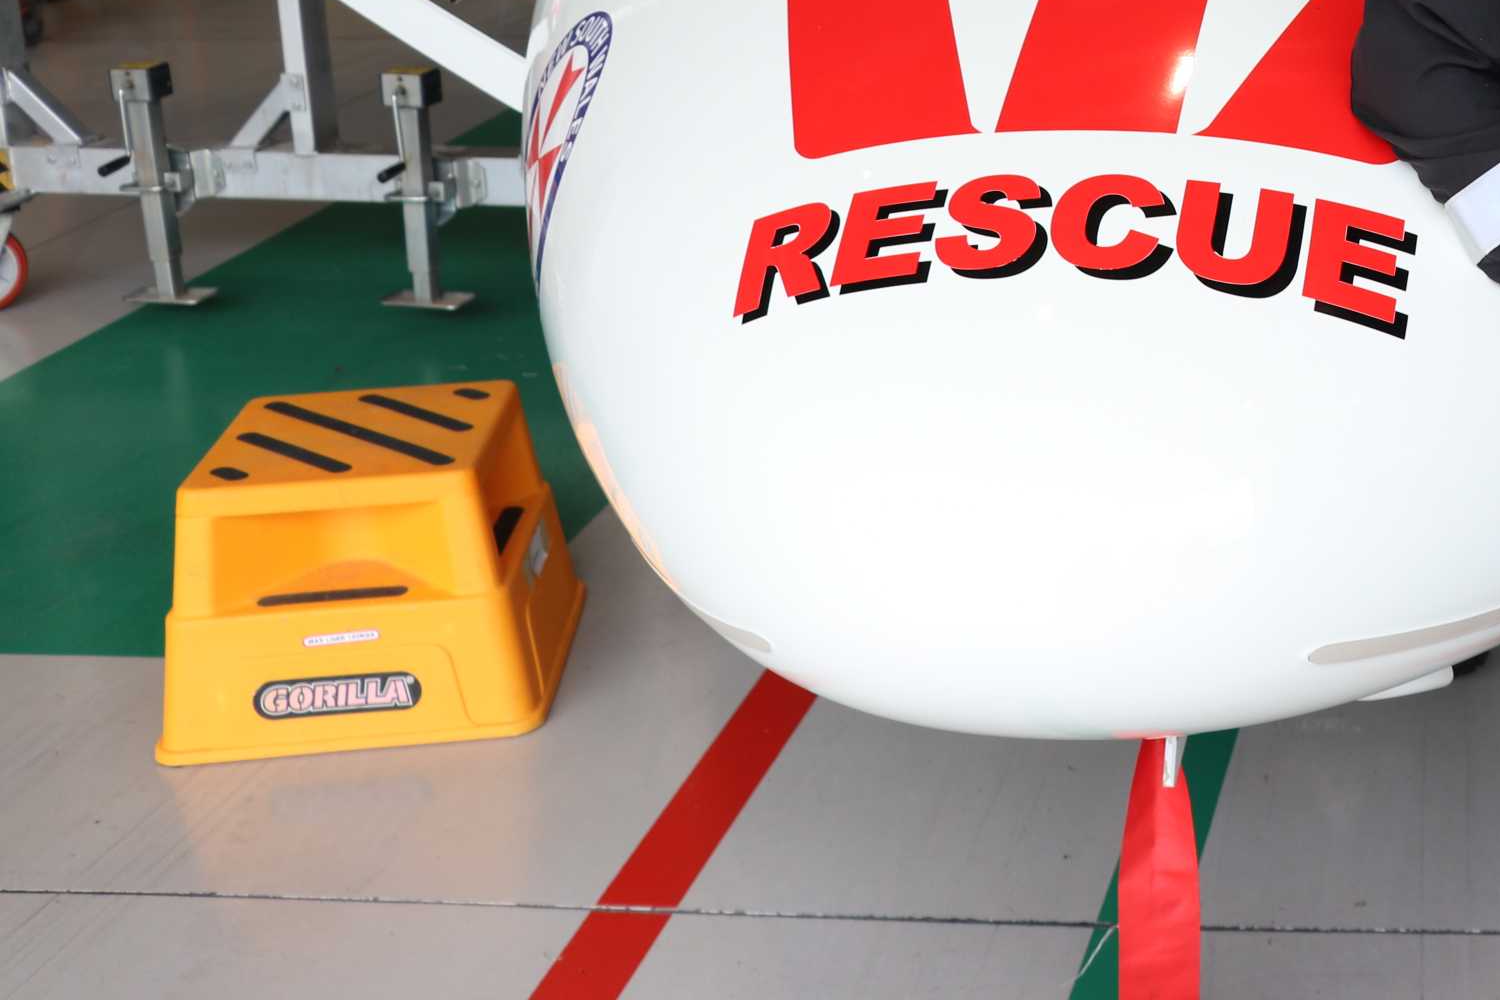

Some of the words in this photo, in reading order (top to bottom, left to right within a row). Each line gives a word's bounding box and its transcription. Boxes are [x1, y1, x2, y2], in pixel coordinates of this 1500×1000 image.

[570, 14, 610, 57] SOUTH
[732, 174, 1418, 340] RESCUE
[260, 676, 414, 716] GORILLA
